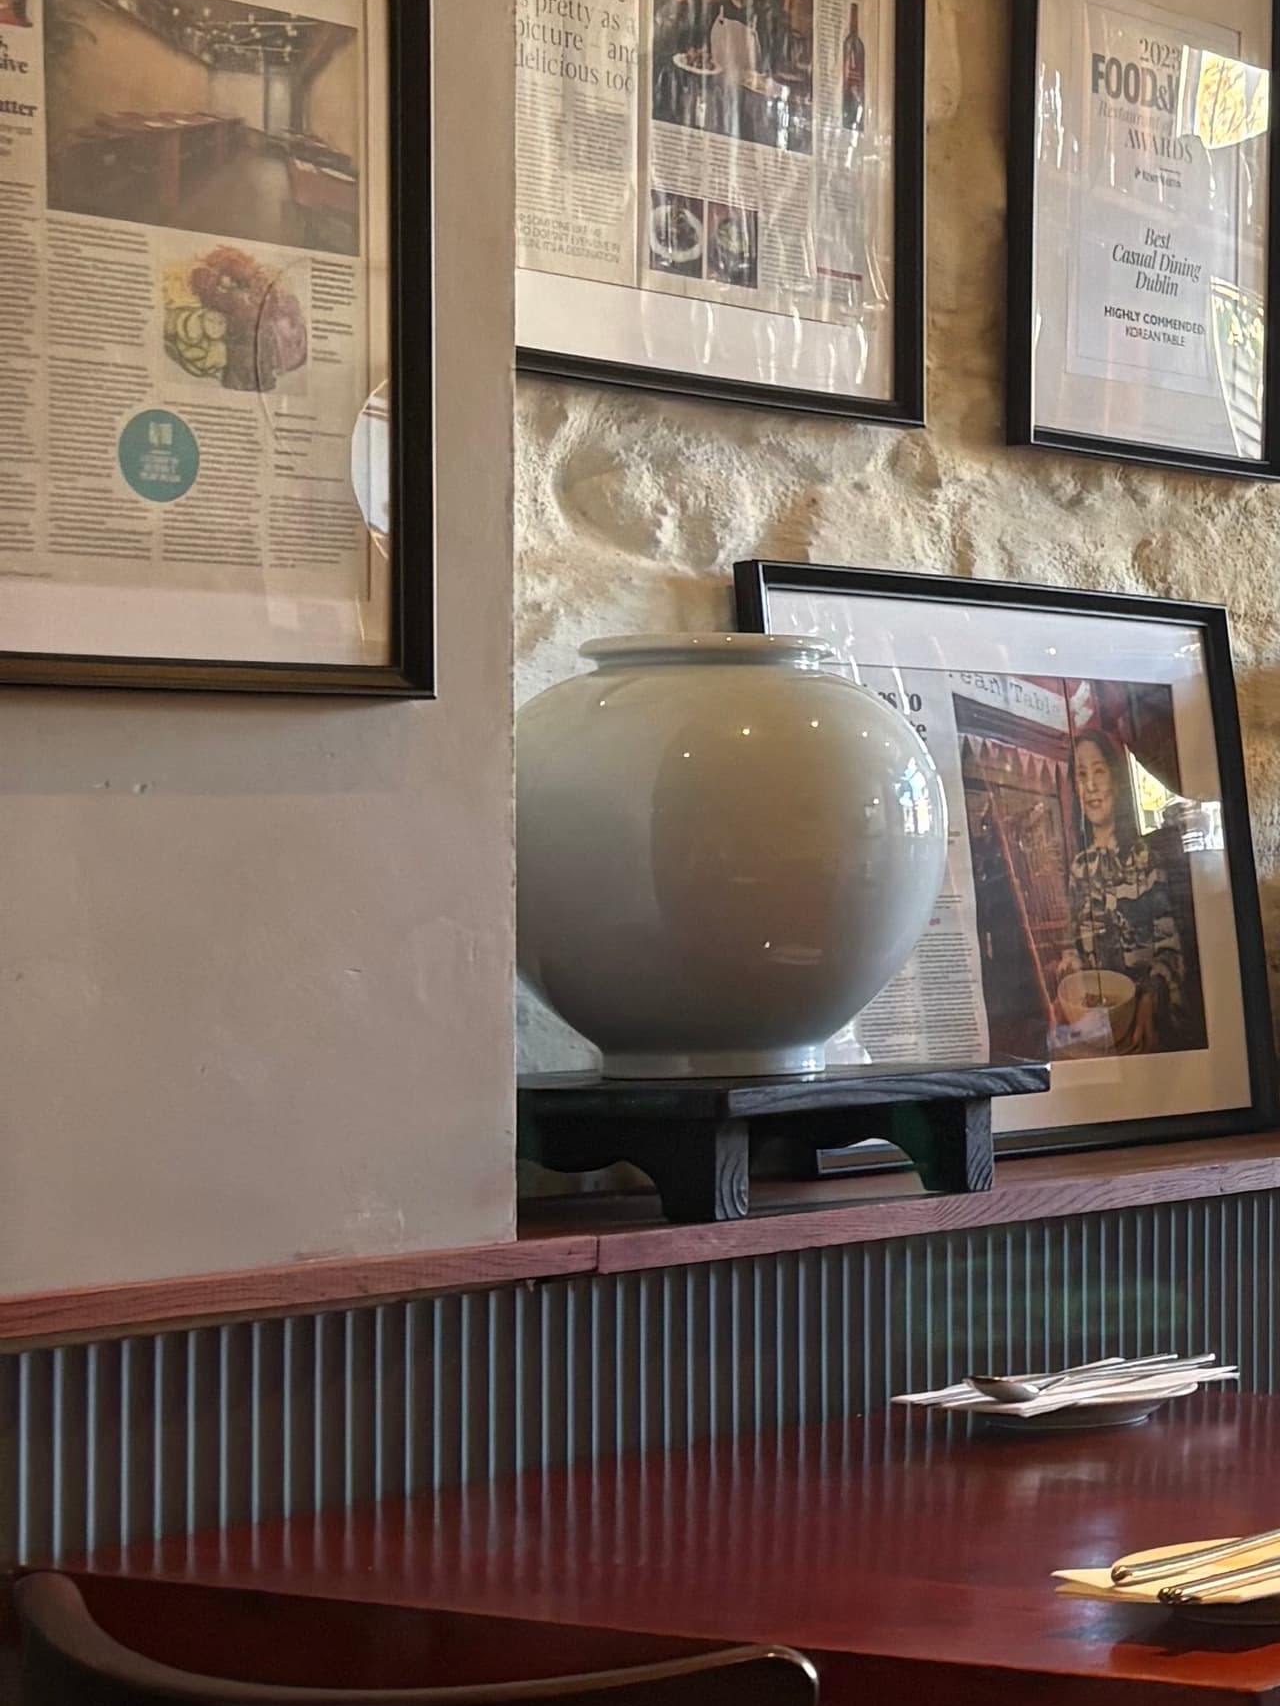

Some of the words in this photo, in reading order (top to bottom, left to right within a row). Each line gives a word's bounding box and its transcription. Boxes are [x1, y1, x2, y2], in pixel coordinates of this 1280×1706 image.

[601, 10, 620, 31] as
[1124, 127, 1193, 164] AWARDS
[1144, 227, 1172, 250] Best
[1112, 242, 1158, 271] Casual
[1159, 253, 1203, 284] Dining
[1134, 270, 1180, 298] Dublin
[1103, 305, 1141, 323] HIGHLY
[1142, 313, 1205, 336] COMMENDED
